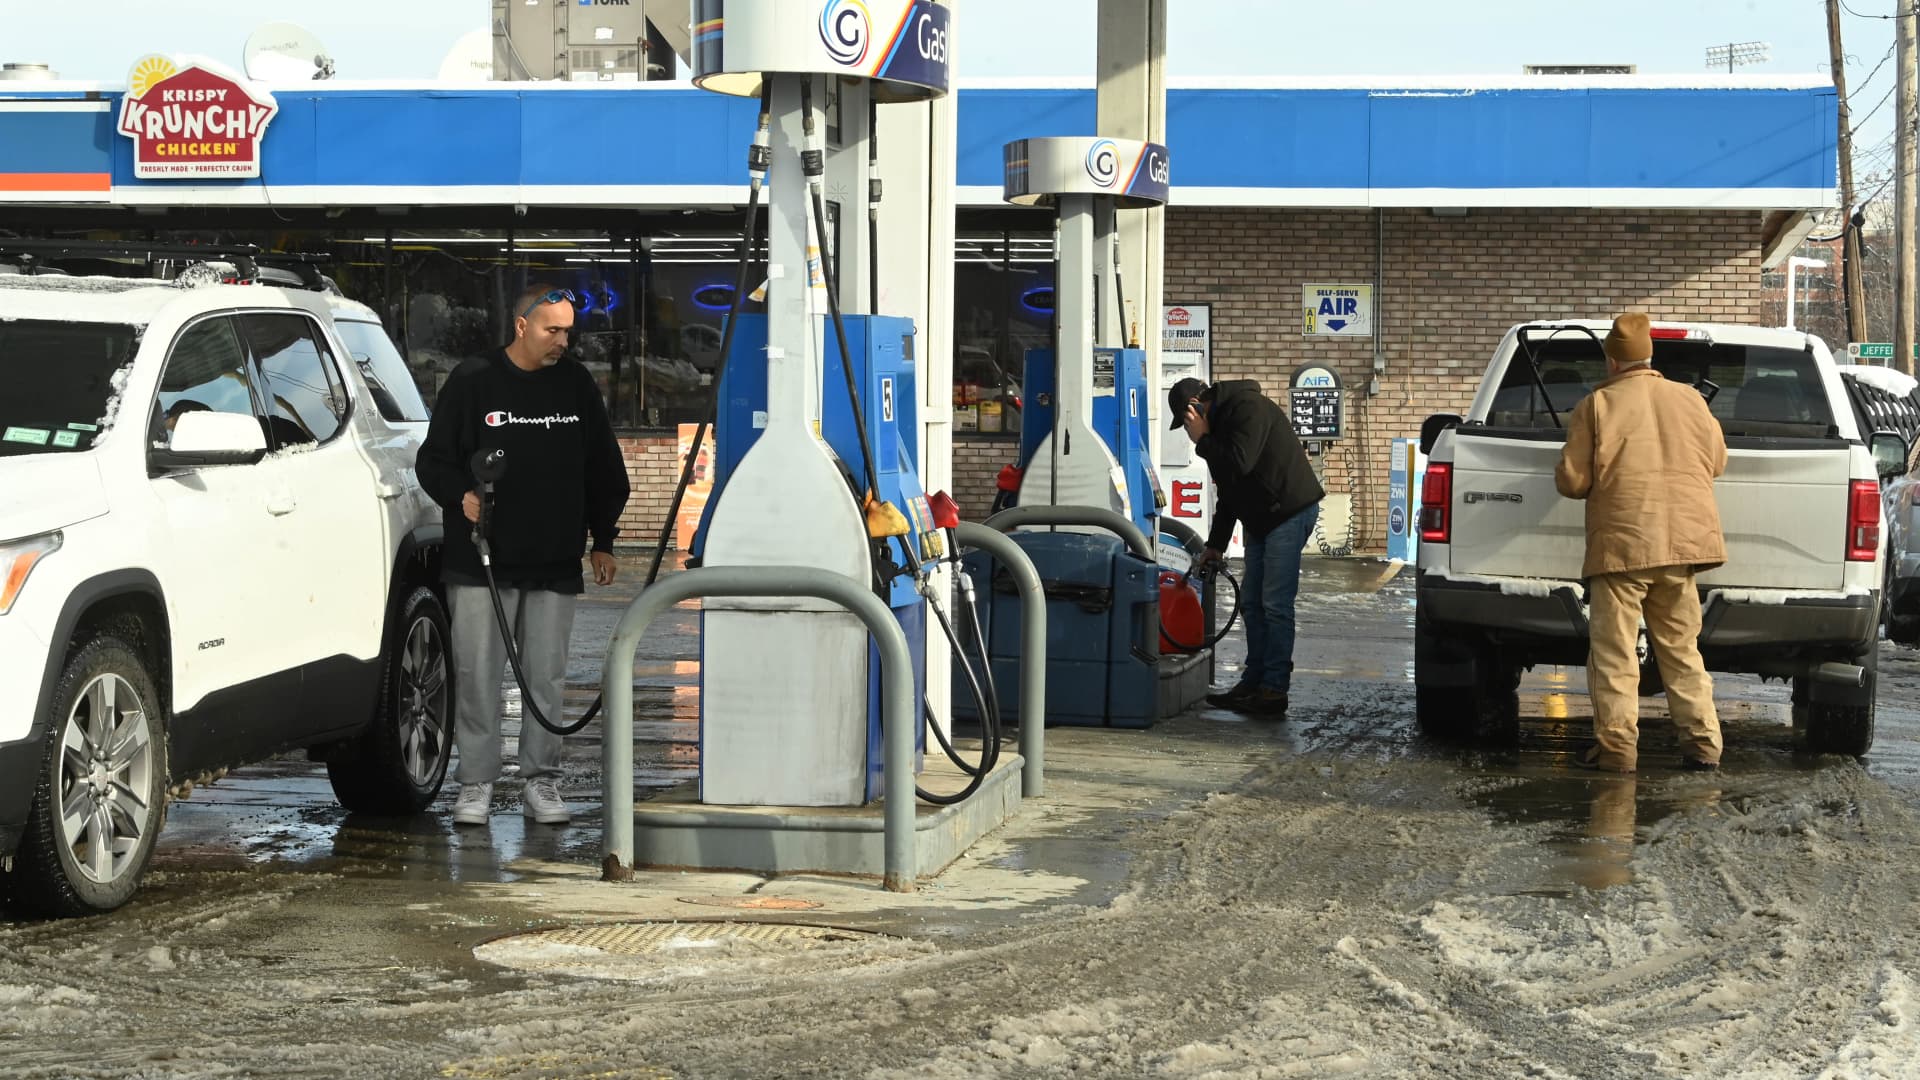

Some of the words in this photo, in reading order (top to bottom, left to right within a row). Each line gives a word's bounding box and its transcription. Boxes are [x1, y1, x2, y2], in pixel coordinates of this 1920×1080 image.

[163, 89, 228, 102] KRISPY
[124, 101, 268, 140] KRUNCHY
[155, 142, 237, 156] CHICKEN
[140, 165, 169, 173] FRESHLY
[170, 165, 189, 173] MADE
[1316, 289, 1359, 297] SELF-SERVE
[1317, 297, 1358, 316] AIR
[1306, 309, 1314, 333] AIR
[1176, 329, 1205, 338] FRESHLY
[1303, 376, 1330, 386] AIR
[883, 380, 892, 420] 5
[485, 411, 580, 430] Champion
[1390, 487, 1405, 499] ZYN
[198, 637, 225, 651] ACADIA
